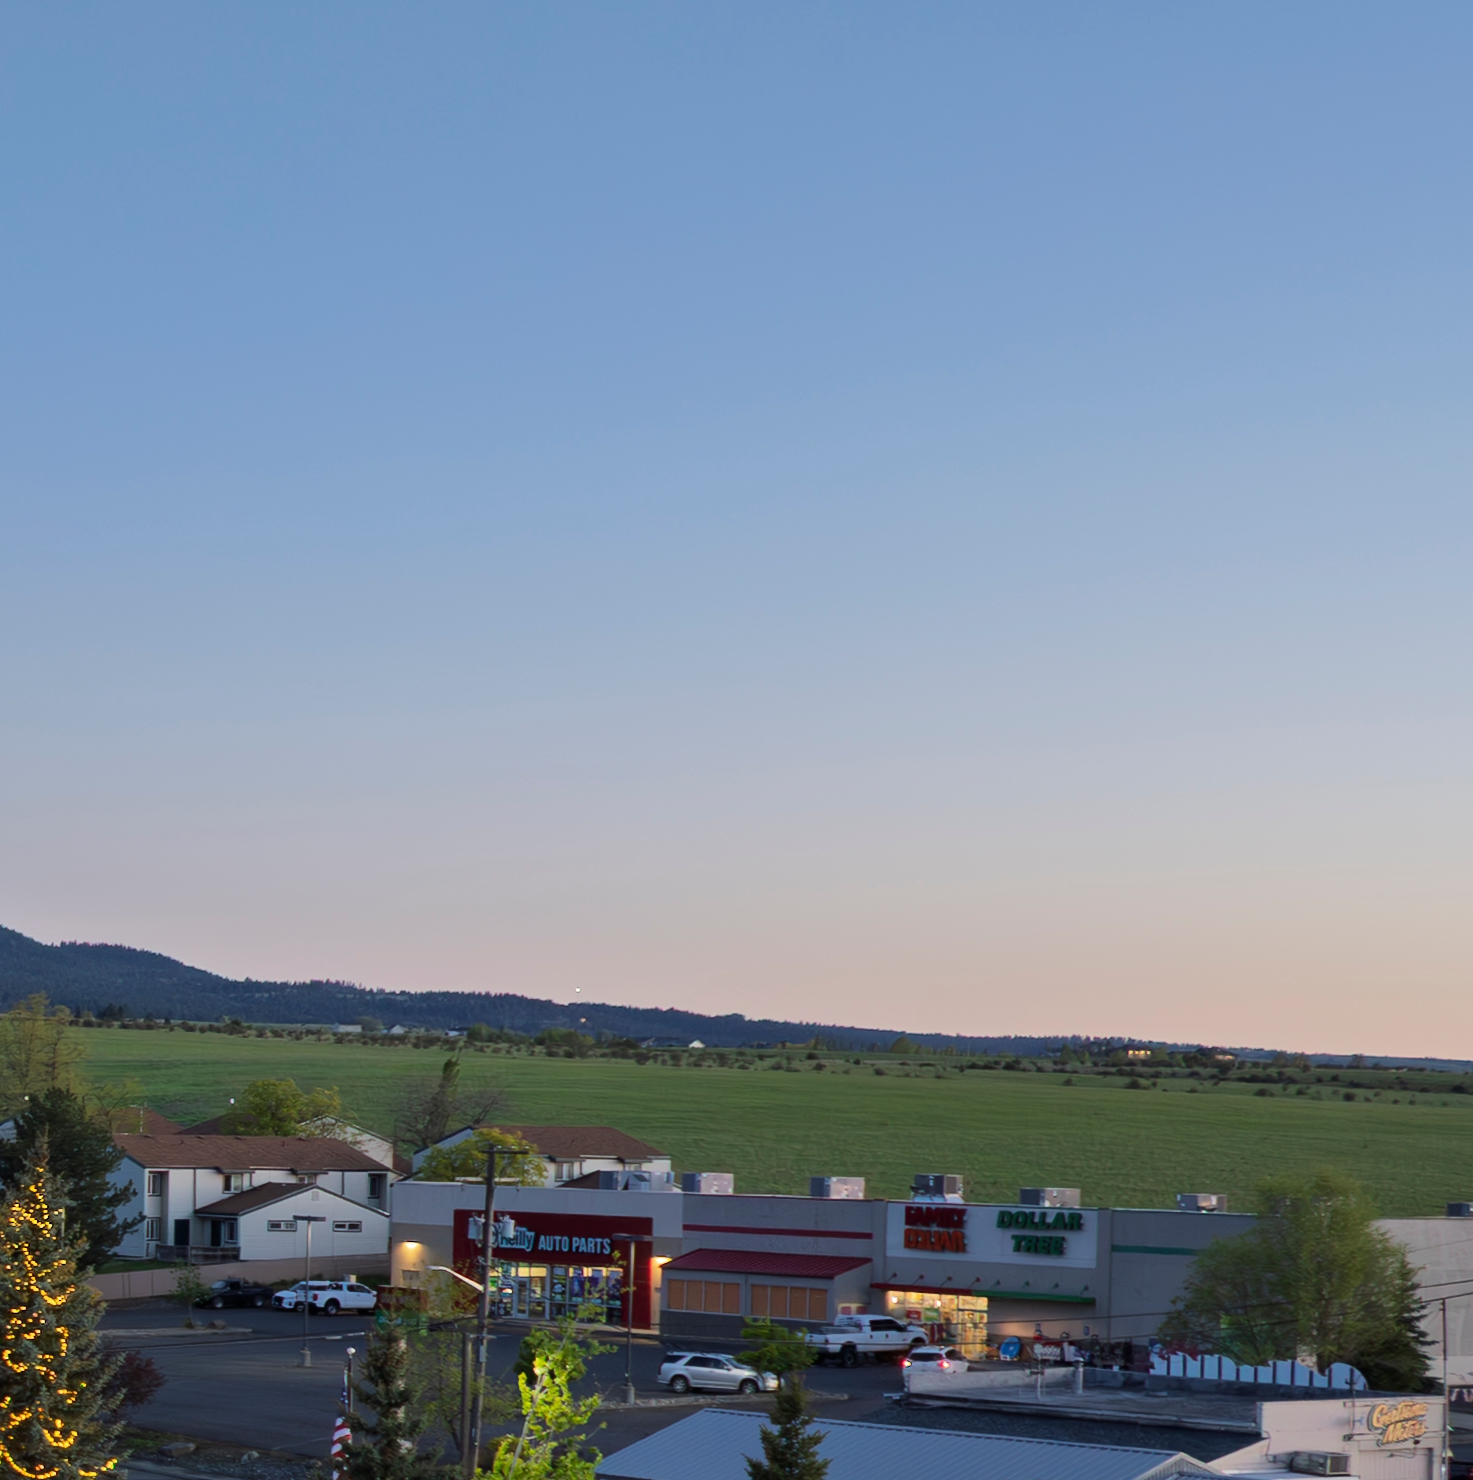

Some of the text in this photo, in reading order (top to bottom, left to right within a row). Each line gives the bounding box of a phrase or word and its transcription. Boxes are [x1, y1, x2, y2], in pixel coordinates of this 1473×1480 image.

[904, 1205, 967, 1229] FAMILY
[997, 1210, 1083, 1231] DOLLAR
[538, 1235, 569, 1252] AUTO
[572, 1236, 611, 1255] PARTS
[1010, 1234, 1065, 1256] TREE
